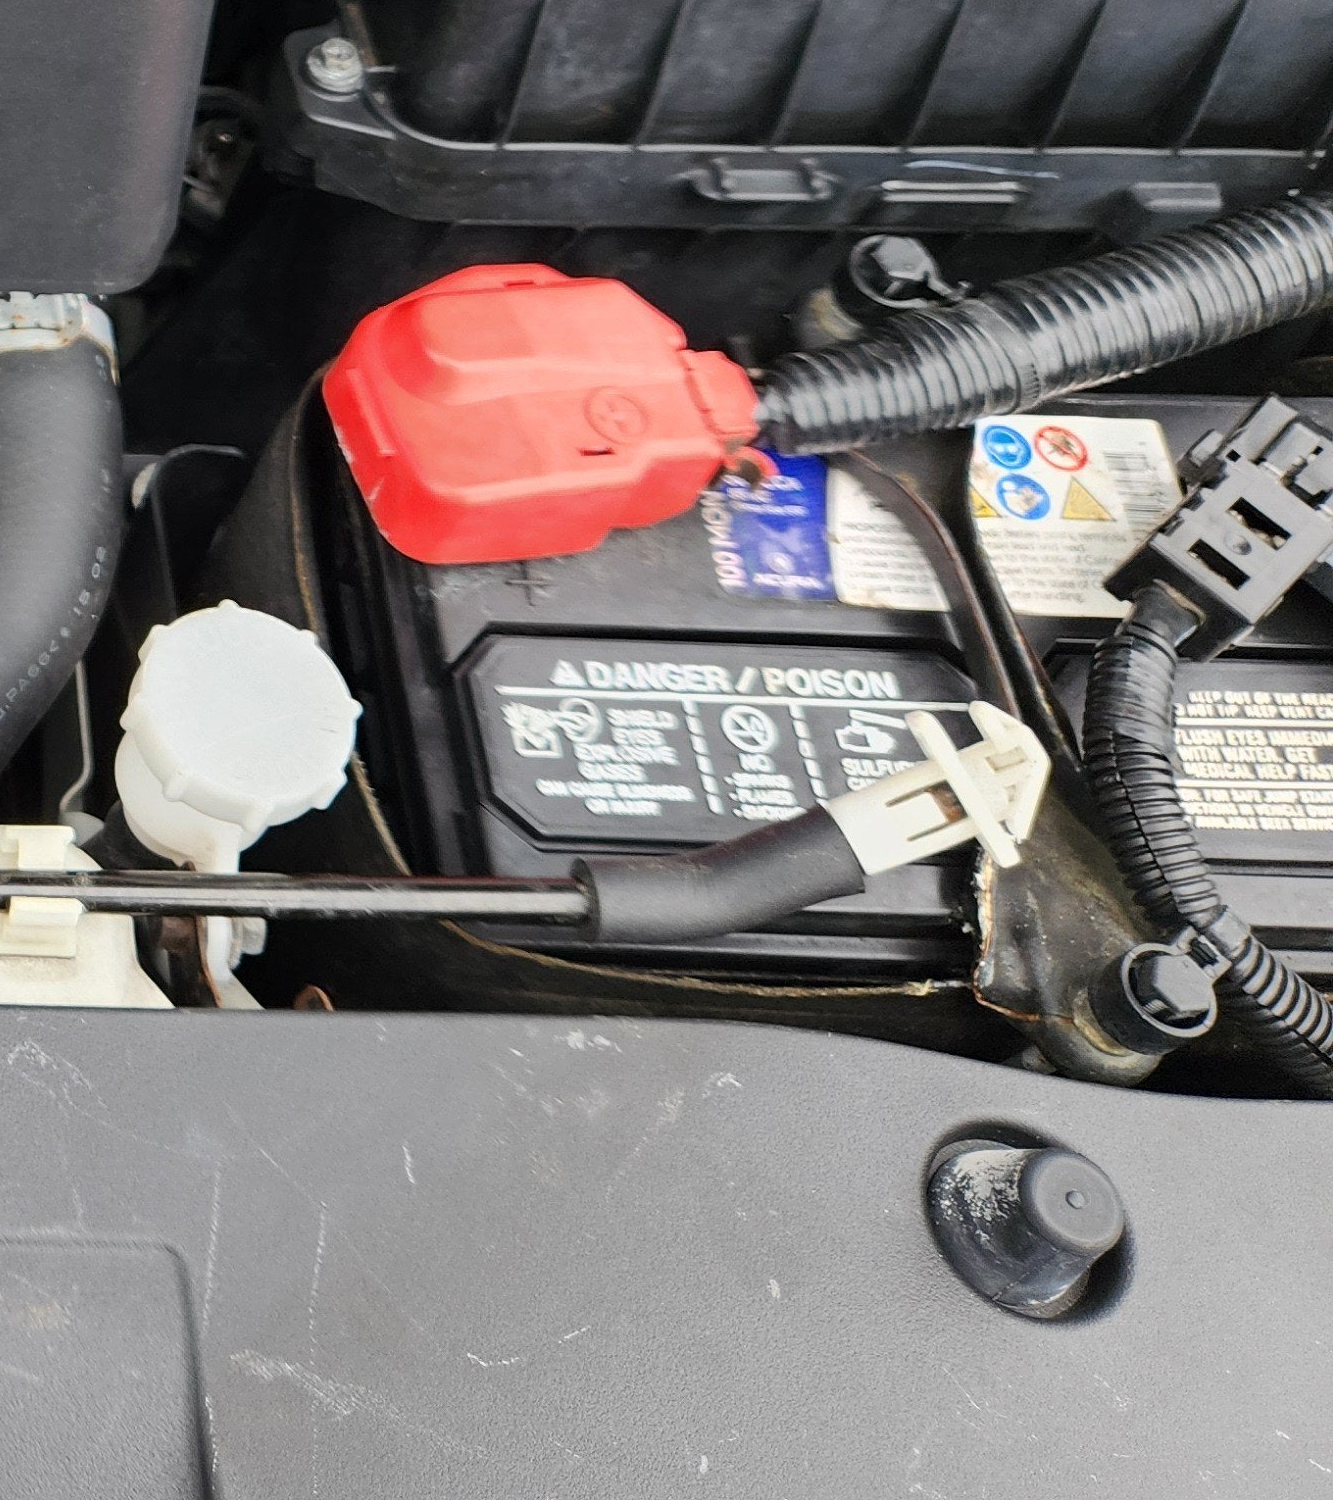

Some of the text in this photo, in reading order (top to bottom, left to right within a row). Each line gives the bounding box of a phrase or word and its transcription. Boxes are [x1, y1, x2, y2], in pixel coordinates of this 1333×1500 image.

[712, 551, 748, 588] 100
[584, 660, 733, 693] DANGER
[760, 667, 902, 699] POISON
[1188, 690, 1222, 703] KEEP
[1224, 691, 1252, 704] OUT
[1253, 691, 1272, 705] OF
[606, 708, 679, 730] SHIELD
[1174, 729, 1225, 746] FLUSH
[1225, 730, 1267, 746] EYES
[738, 753, 775, 773] NO
[1177, 746, 1222, 762] WITH
[1285, 747, 1318, 763] GET
[1184, 762, 1256, 779] MEDICAL
[1255, 763, 1297, 779] HELP
